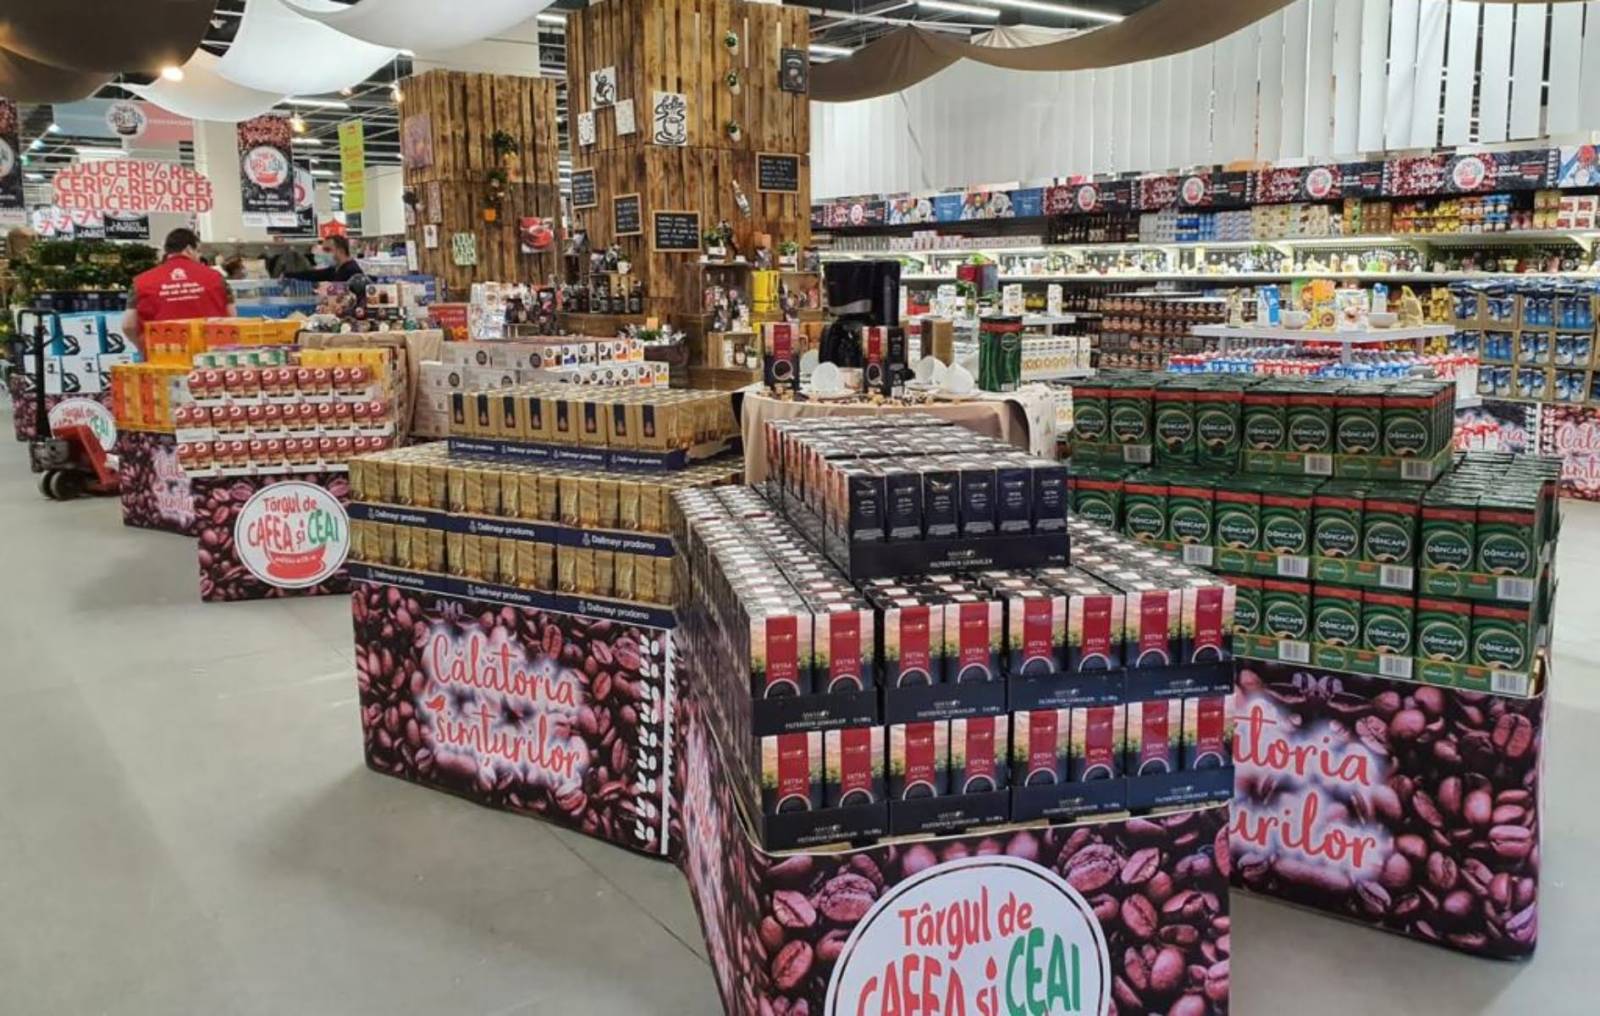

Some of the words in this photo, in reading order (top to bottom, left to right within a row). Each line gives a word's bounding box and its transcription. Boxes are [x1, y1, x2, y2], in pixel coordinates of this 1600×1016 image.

[247, 514, 294, 552] CAFEA
[308, 509, 339, 544] CEAI
[263, 491, 302, 518] Târgul
[303, 496, 317, 512] de
[477, 522, 503, 534] Dallmayr
[591, 534, 621, 546] Dallmayr
[623, 538, 656, 550] prodomo
[587, 602, 616, 615] Dallmayr
[617, 604, 649, 620] prodomo
[432, 633, 577, 708] Călătoria
[434, 703, 582, 780] simțurilor
[1232, 704, 1371, 787] toria
[898, 886, 991, 961] Târgul
[998, 891, 1033, 932] de
[1005, 927, 1081, 1014] CEAI
